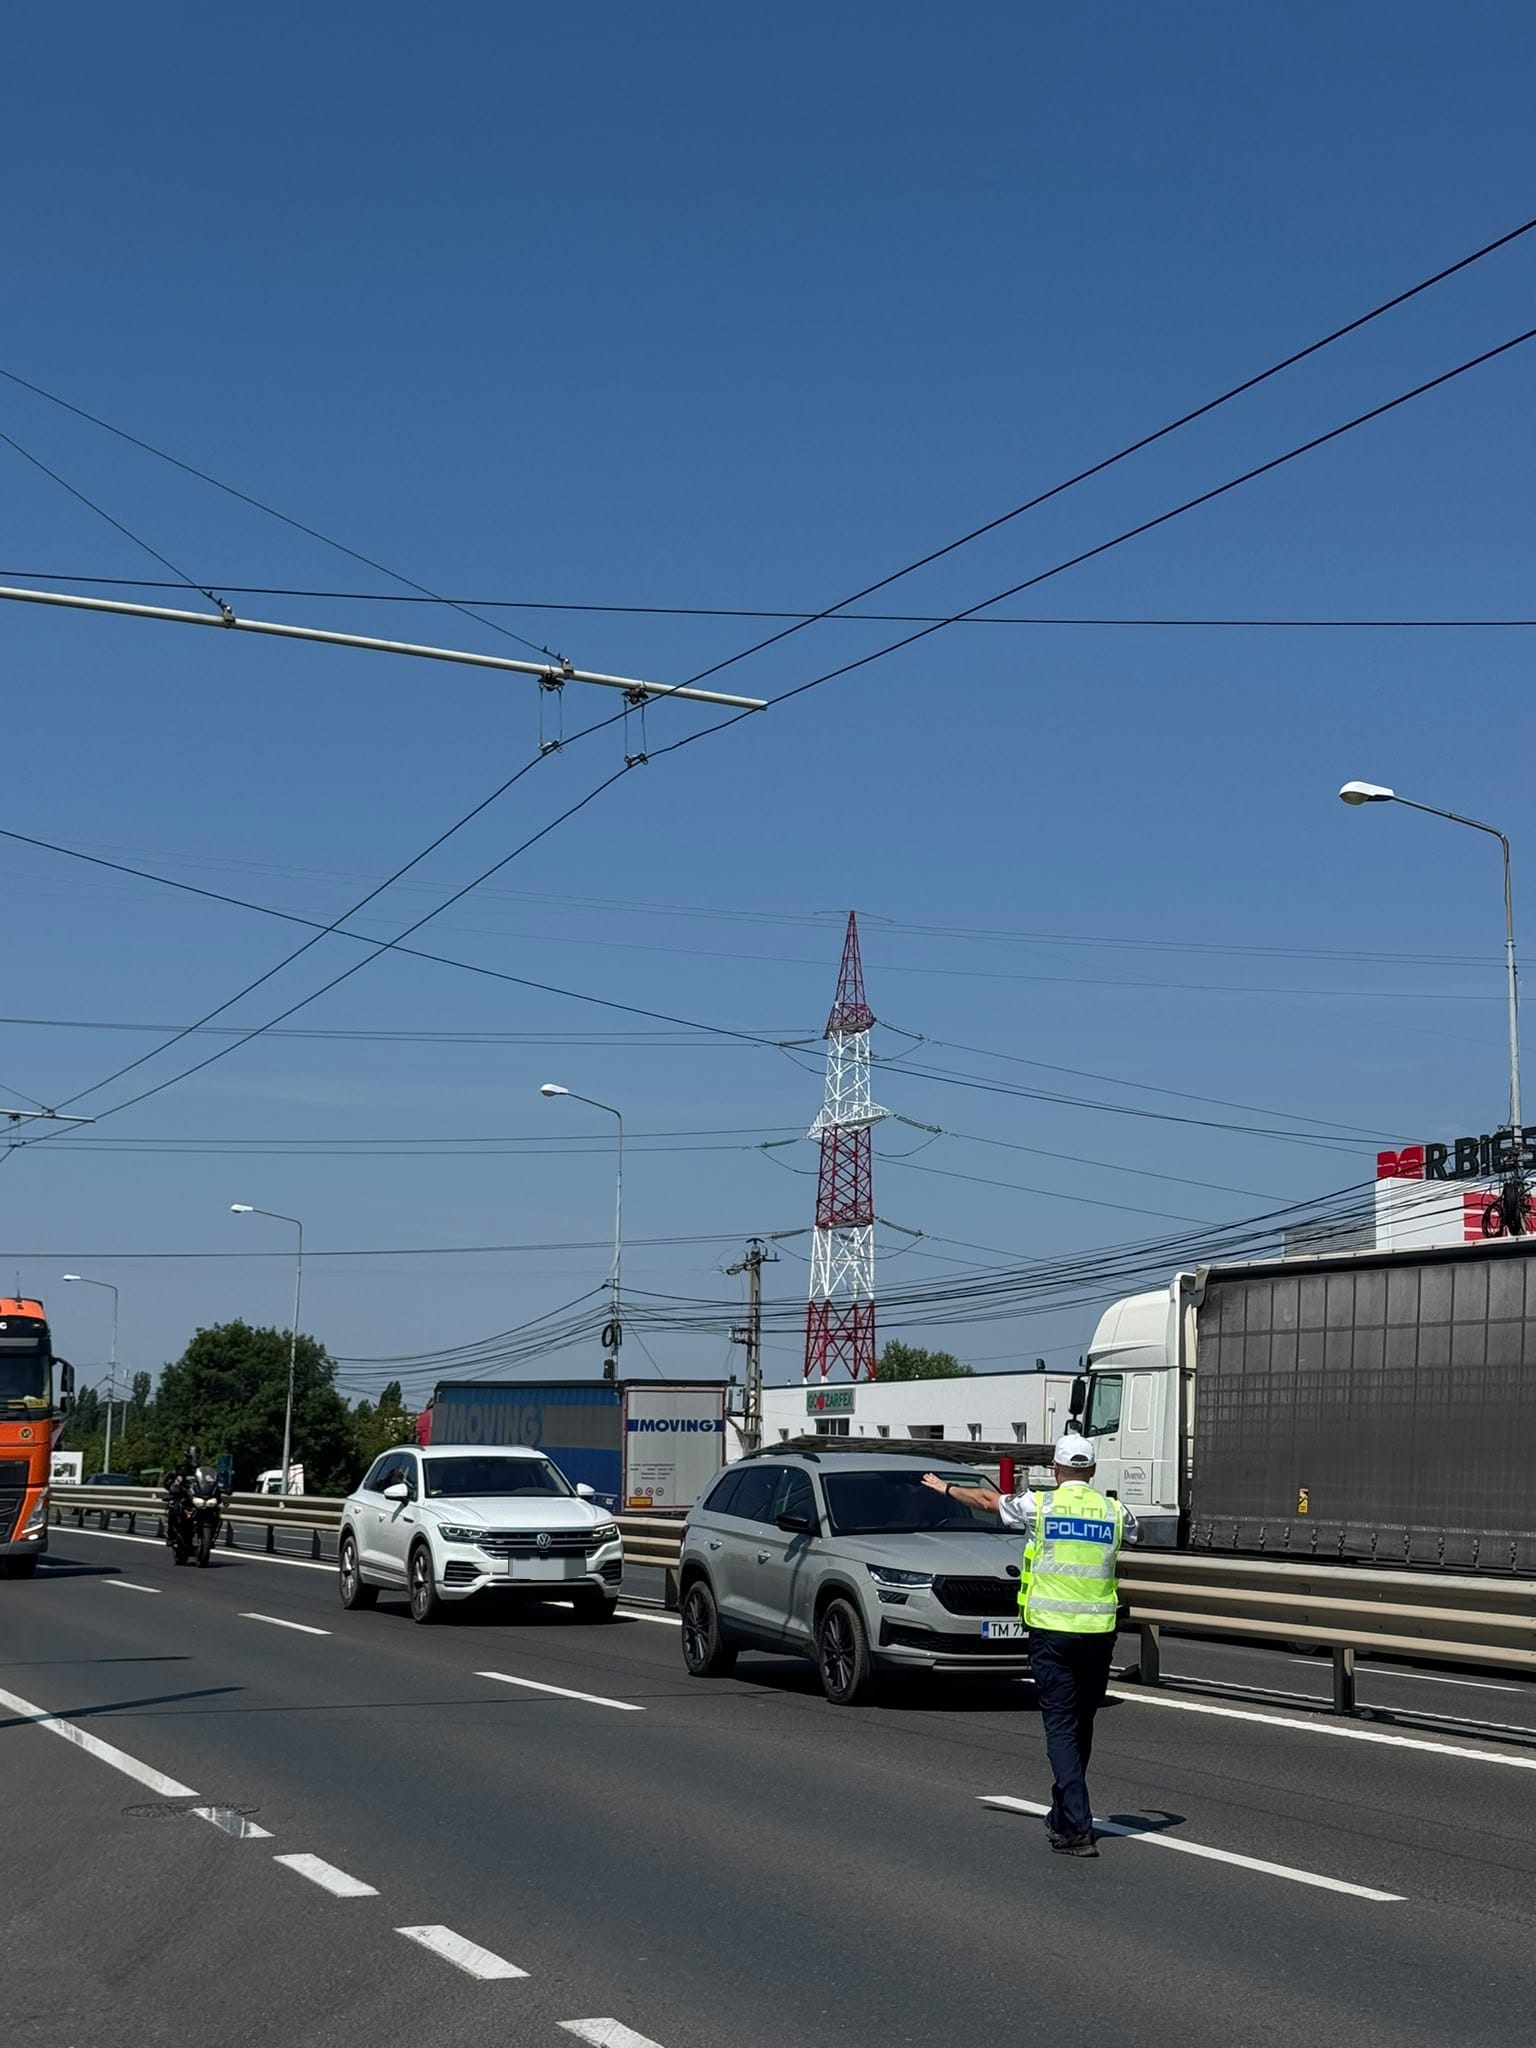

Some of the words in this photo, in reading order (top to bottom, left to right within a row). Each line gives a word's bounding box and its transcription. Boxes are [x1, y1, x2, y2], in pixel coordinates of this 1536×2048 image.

[450, 1402, 538, 1447] MOVING
[639, 1419, 714, 1433] MOVING
[1046, 1520, 1113, 1540] POLITIA
[991, 1623, 1009, 1637] TM
